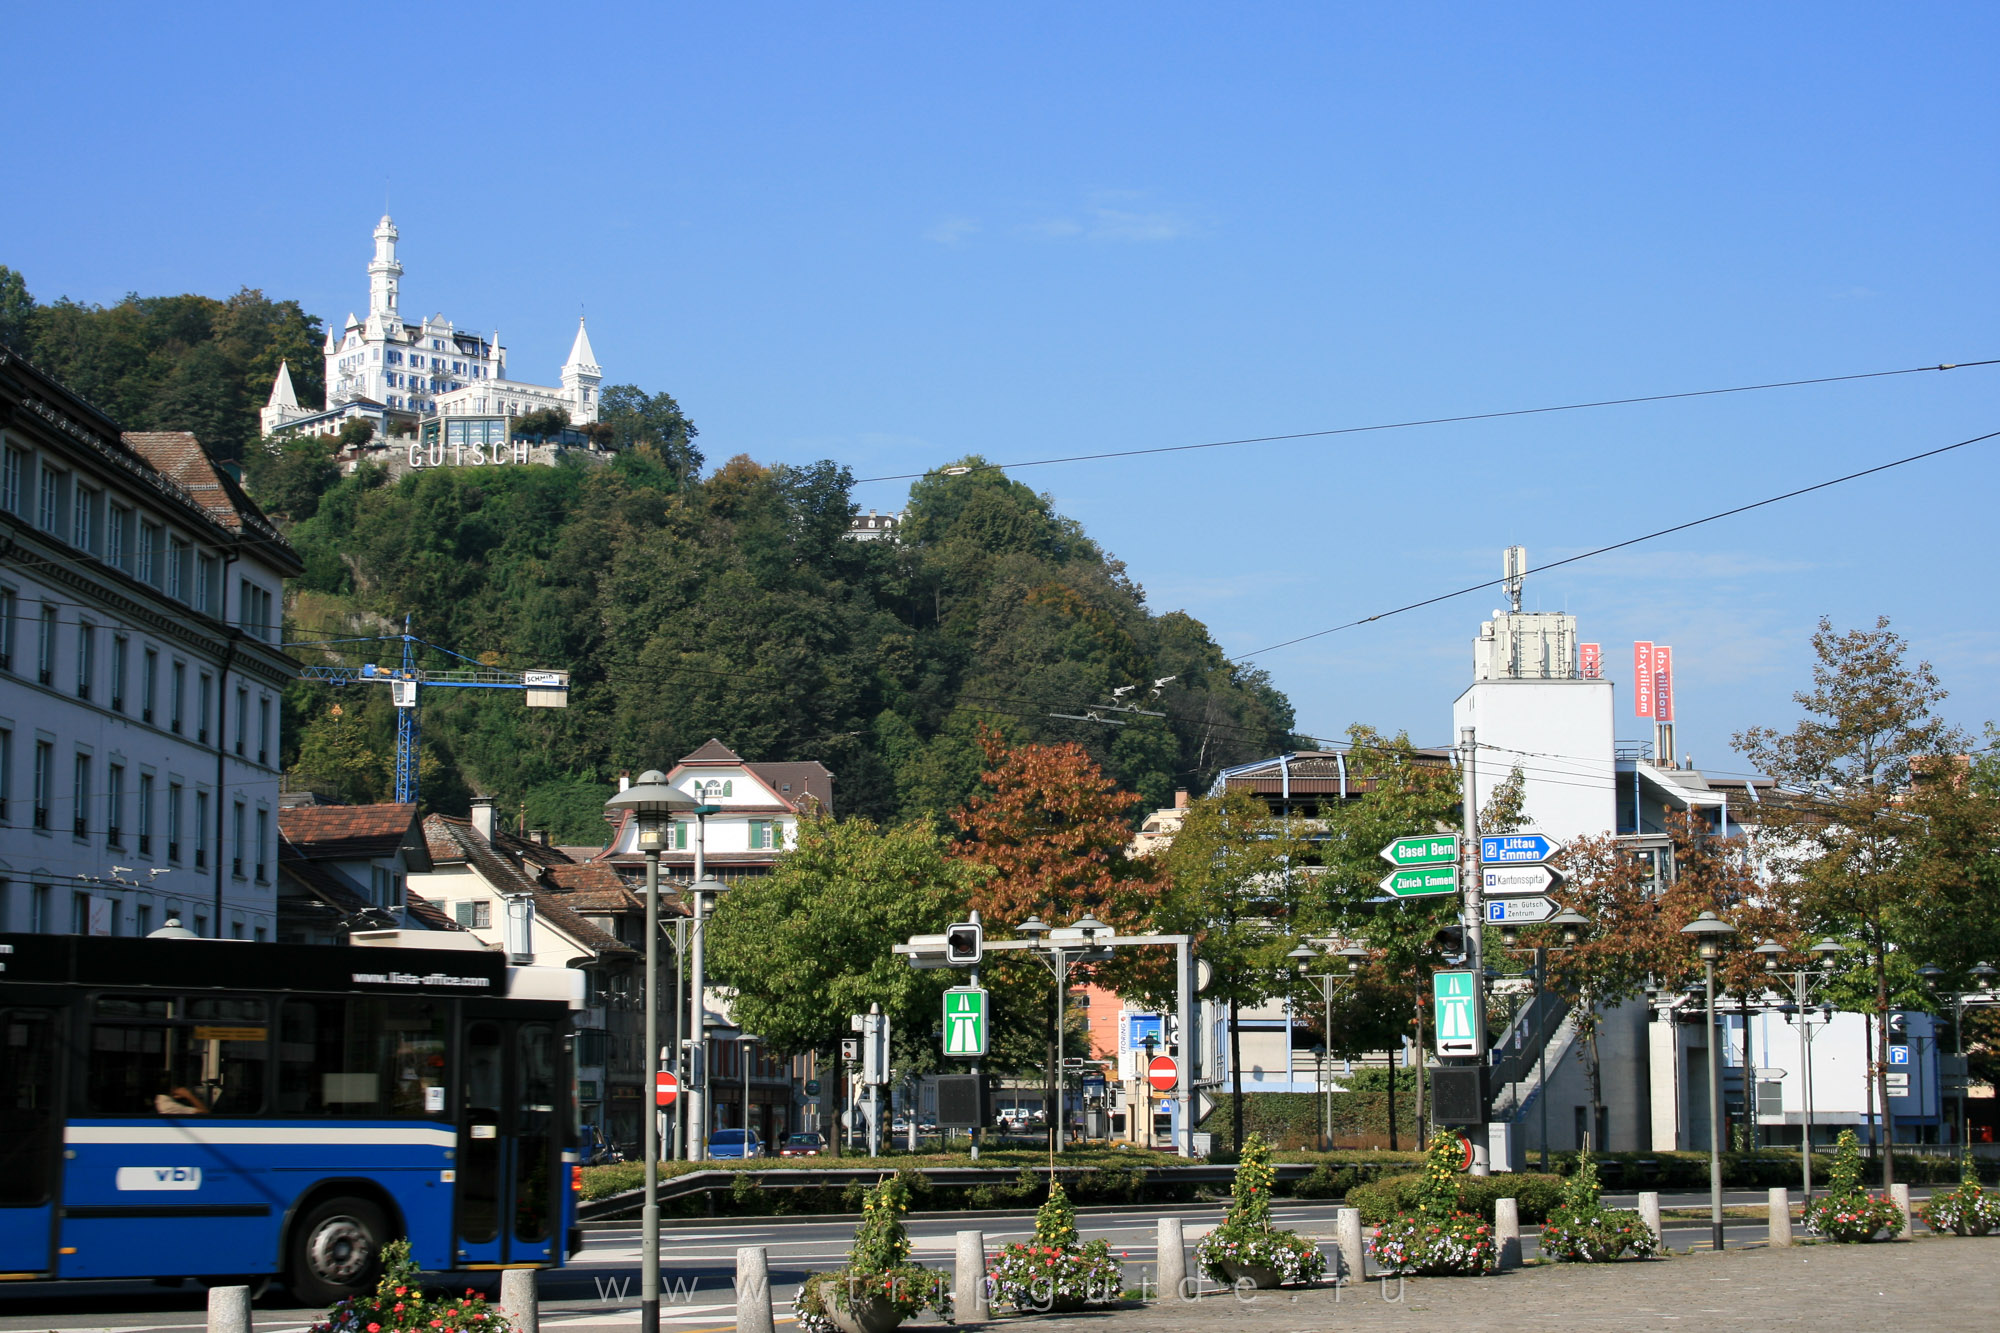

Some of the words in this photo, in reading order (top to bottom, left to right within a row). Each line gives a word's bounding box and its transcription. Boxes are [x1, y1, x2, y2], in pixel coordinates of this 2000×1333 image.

[1503, 838, 1535, 849] Littau
[1398, 843, 1426, 858] Basel
[1431, 842, 1454, 856] Bern
[1487, 845, 1495, 856] 2
[1499, 849, 1539, 860] Emmen
[1397, 876, 1422, 889] Zürich
[1425, 875, 1454, 887] Emmen
[1487, 875, 1495, 886] H
[1497, 874, 1545, 887] Kantonsspital
[1493, 907, 1500, 919] P
[1894, 1052, 1904, 1063] P
[153, 1167, 196, 1182] vbl
